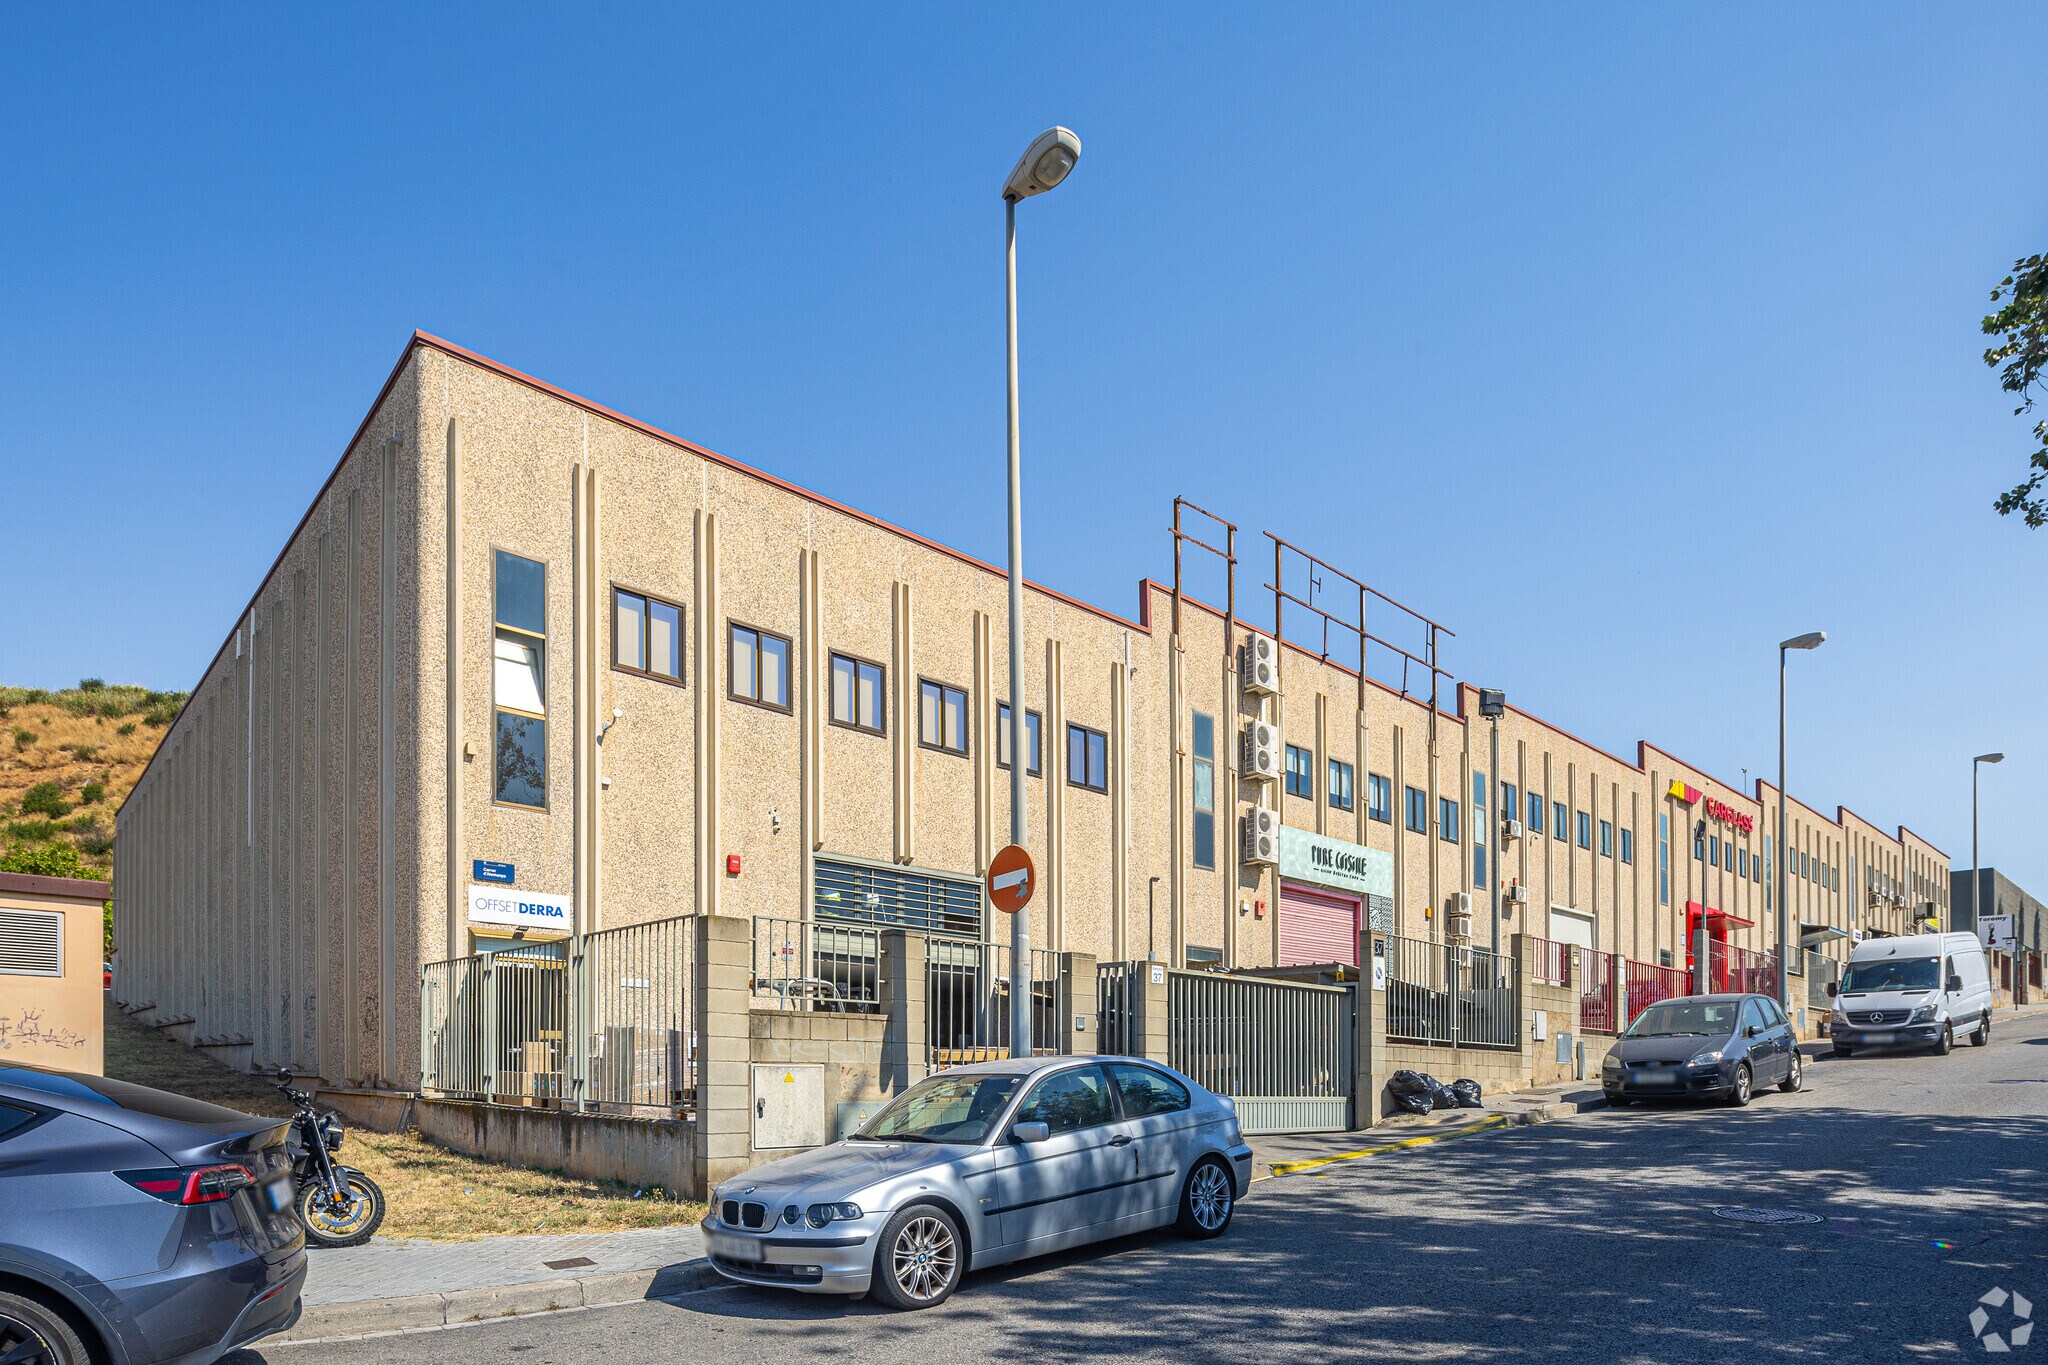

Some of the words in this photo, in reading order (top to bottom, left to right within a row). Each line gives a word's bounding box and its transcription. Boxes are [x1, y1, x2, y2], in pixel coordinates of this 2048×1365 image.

[1706, 797, 1753, 832] CARGLASS
[1311, 845, 1333, 867] PURE
[1153, 972, 1162, 982] 37
